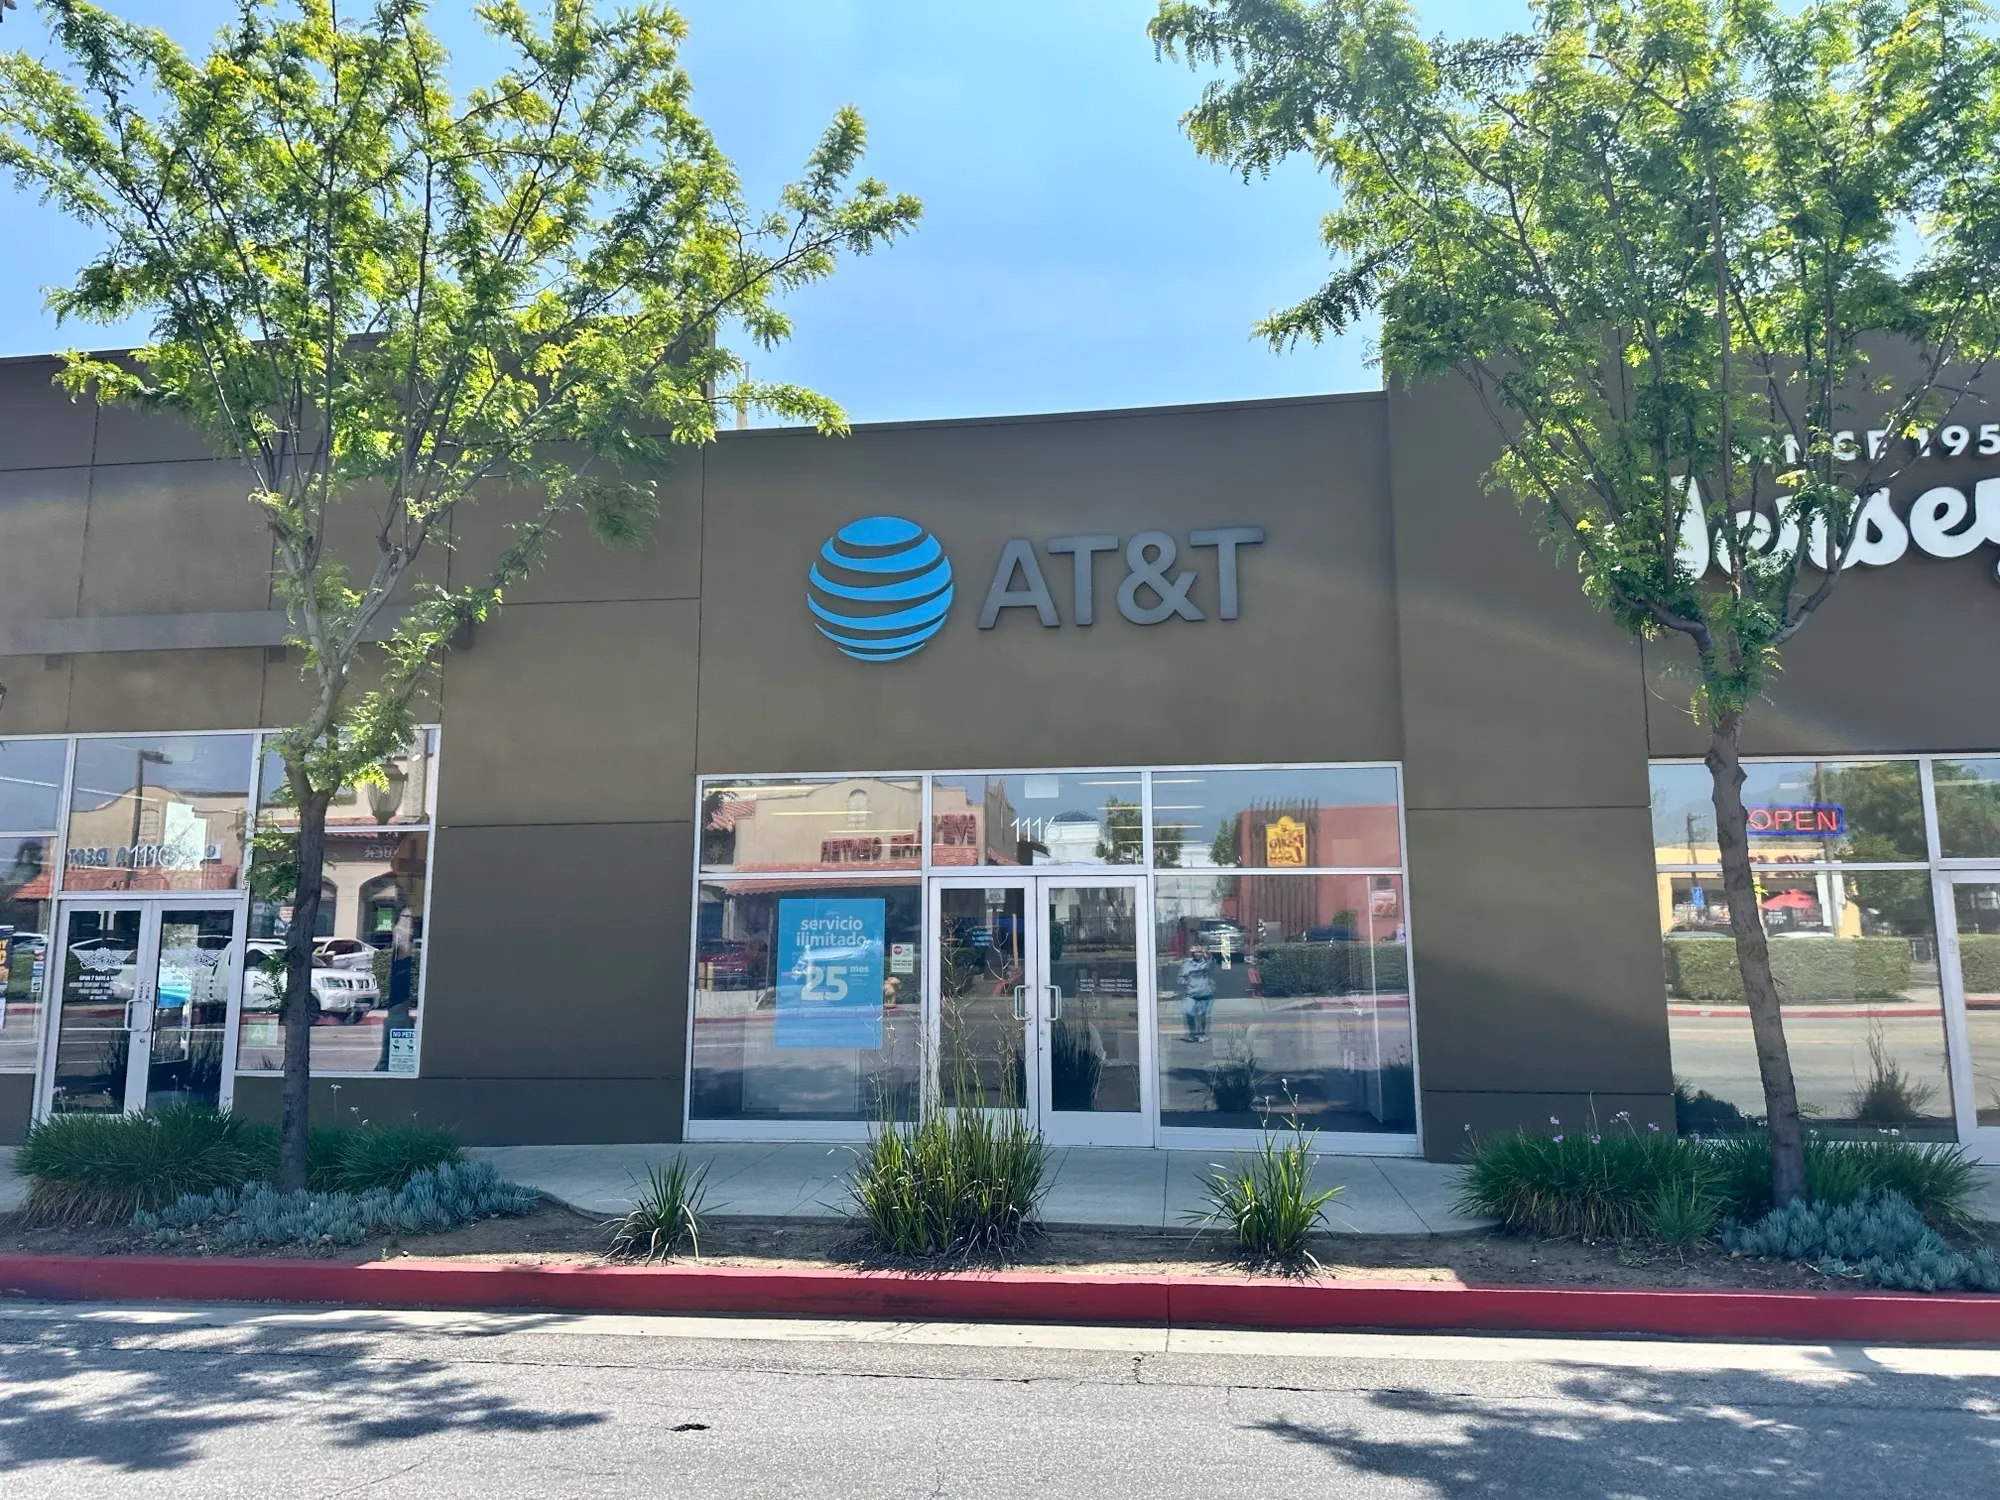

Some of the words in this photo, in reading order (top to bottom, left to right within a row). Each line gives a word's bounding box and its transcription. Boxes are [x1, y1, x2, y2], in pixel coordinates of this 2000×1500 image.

[977, 526, 1264, 630] AT&T
[1010, 816, 1062, 843] 1116
[1748, 808, 1837, 831] OPEN
[800, 916, 863, 931] servicio
[796, 932, 867, 947] ilimitado
